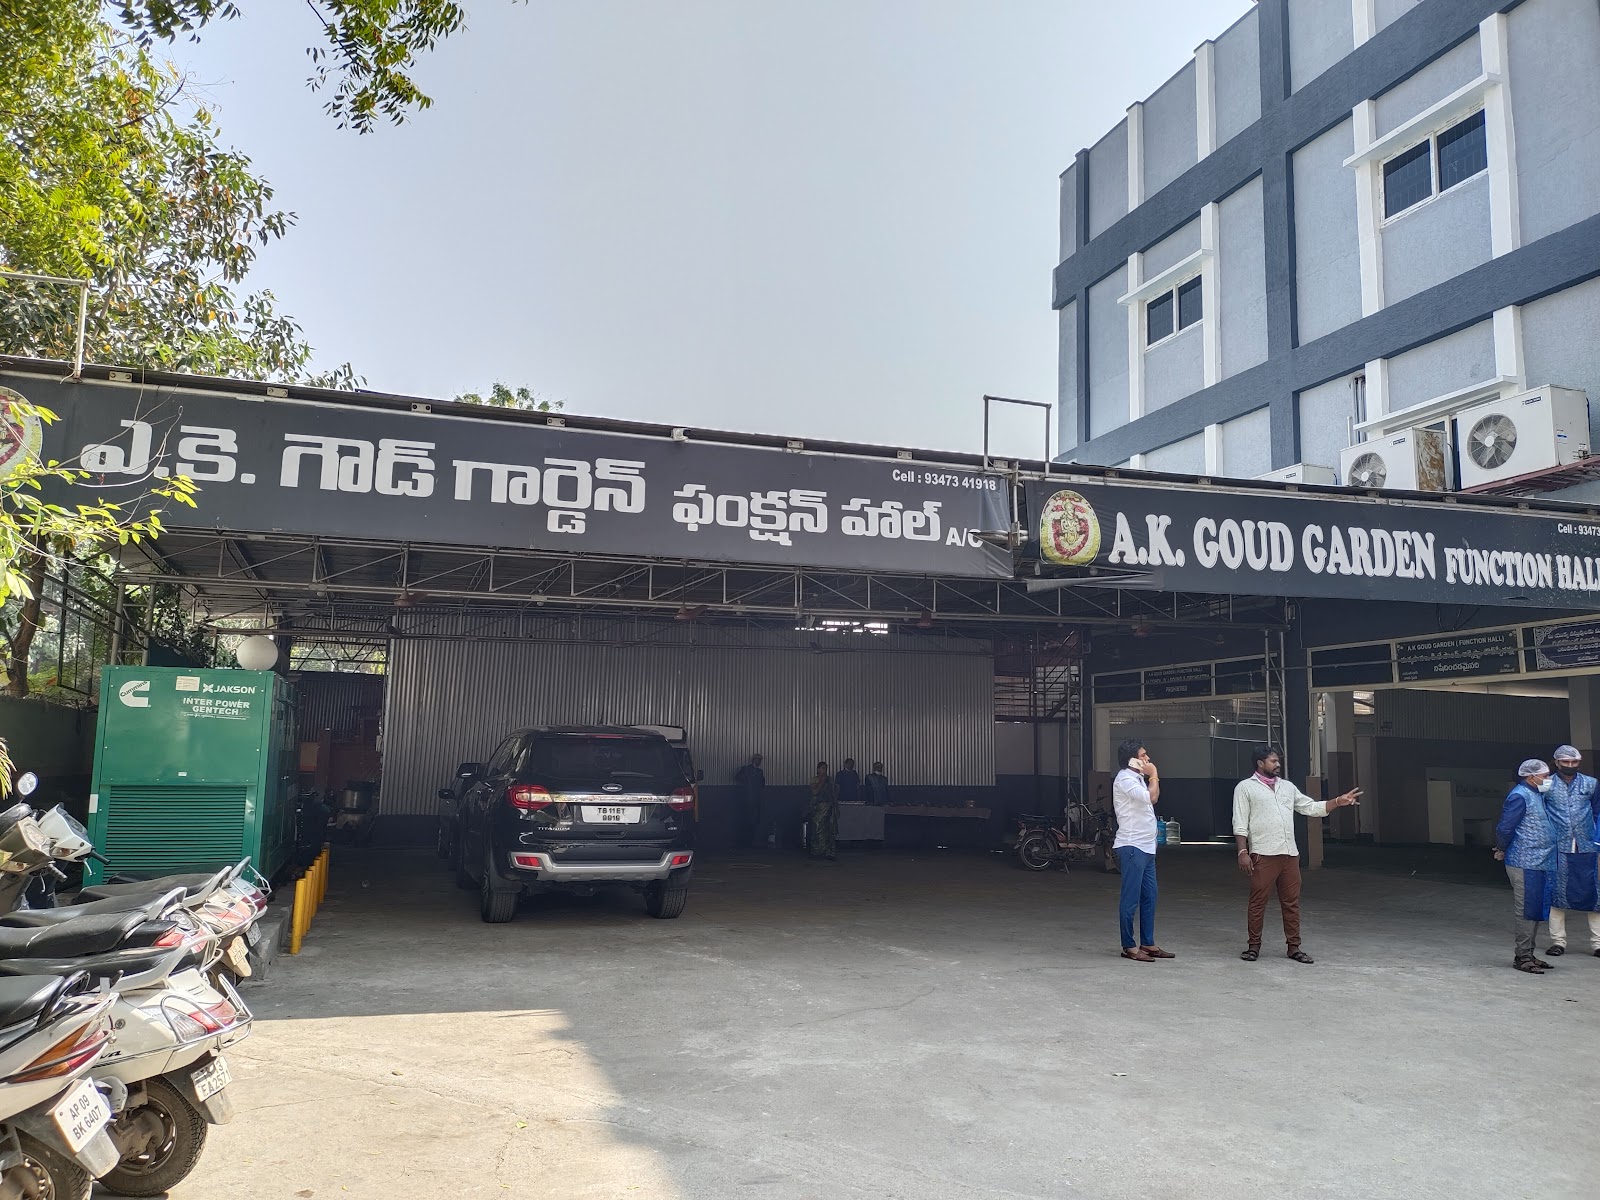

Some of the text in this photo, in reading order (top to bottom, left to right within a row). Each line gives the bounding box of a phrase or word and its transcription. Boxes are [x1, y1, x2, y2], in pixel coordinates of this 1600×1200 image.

[892, 469, 915, 483] Cell
[924, 472, 959, 487] 93473
[961, 477, 997, 491] 41918
[279, 433, 436, 498] గౌడ్
[452, 457, 646, 534] గార్డెన్
[672, 483, 828, 547] ఫంక్షన్
[841, 497, 942, 541] హాల్
[1557, 522, 1573, 534] Cell
[1107, 511, 1186, 568] A.K.
[1193, 517, 1295, 573] GOUD
[1301, 524, 1437, 580] GARDEN
[1444, 547, 1553, 590] FUNCTION
[1432, 641, 1455, 650] GARDEN
[120, 680, 148, 697] Cummins
[213, 685, 256, 694] JAKSON
[183, 697, 250, 709] INTER POWER
[192, 706, 239, 715] GENTECH
[69, 1094, 90, 1121] AP 09
[72, 1104, 103, 1141] BK 6407
